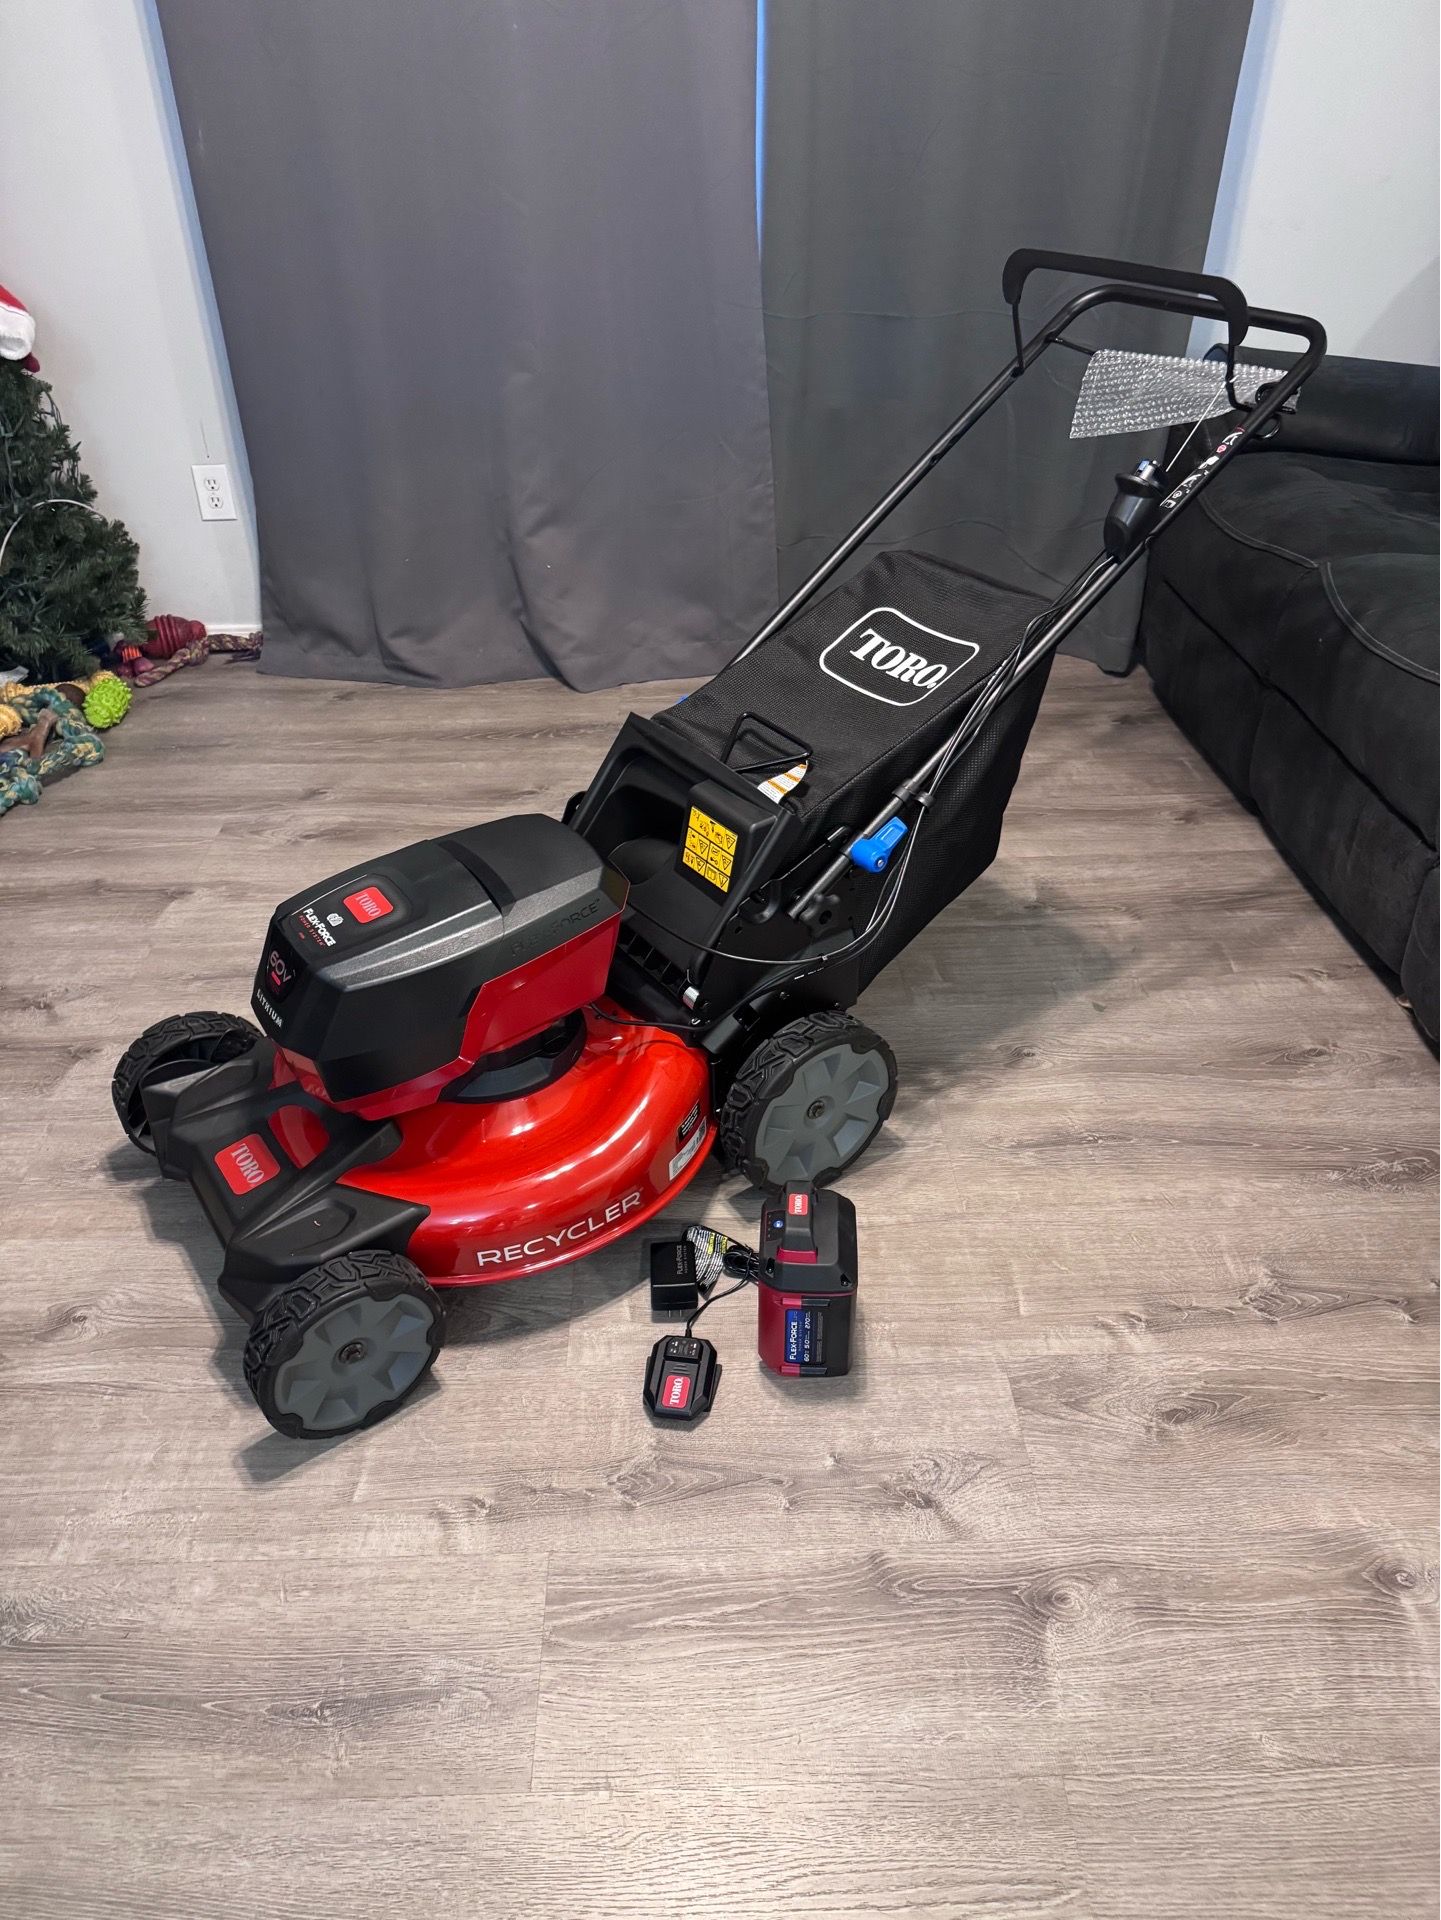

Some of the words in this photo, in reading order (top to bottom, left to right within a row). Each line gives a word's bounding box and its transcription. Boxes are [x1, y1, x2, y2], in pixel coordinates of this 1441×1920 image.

[850, 628, 948, 688] TORO
[355, 893, 382, 917] TORO
[256, 988, 283, 1028] LITHIUM
[231, 1143, 265, 1184] TORO
[794, 1194, 803, 1215] TORO
[476, 1190, 641, 1267] RECYCLER
[670, 1377, 684, 1405] TORO
